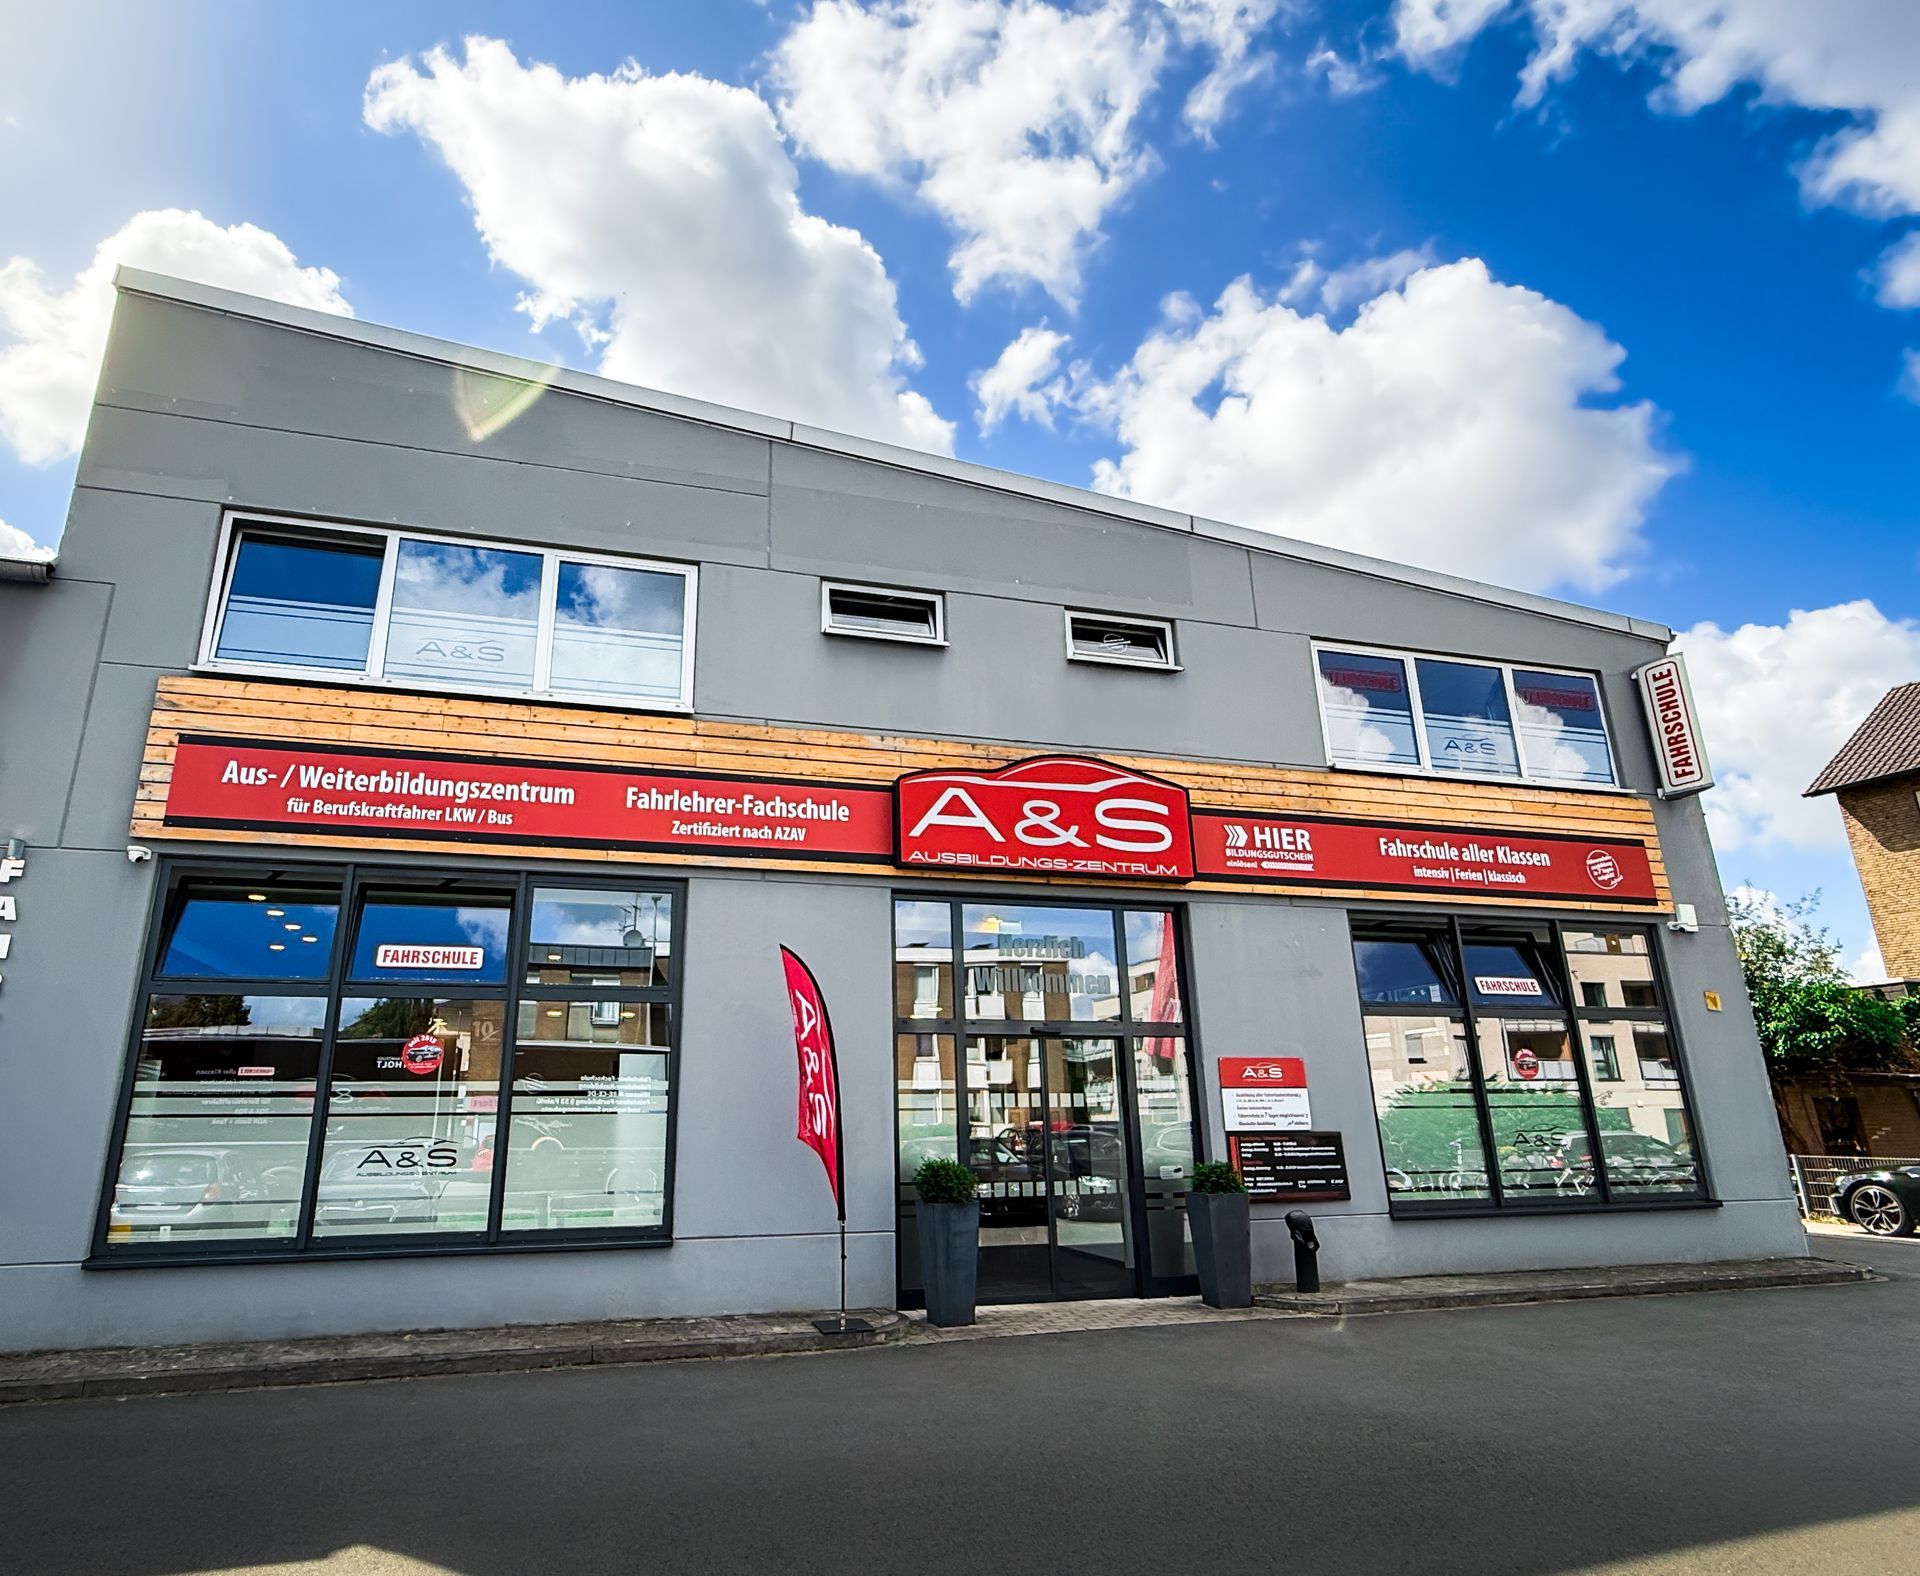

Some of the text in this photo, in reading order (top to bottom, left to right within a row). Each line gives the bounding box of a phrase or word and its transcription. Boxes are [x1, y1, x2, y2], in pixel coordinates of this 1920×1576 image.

[416, 641, 505, 662] A&S
[1652, 668, 1695, 779] FAHRSCHULE
[1443, 739, 1497, 755] A&S
[221, 760, 277, 785] Aus-
[299, 765, 575, 805] Weiterbildungszentrum
[287, 797, 310, 813] für
[313, 799, 443, 821] Berufskraftfahrer
[444, 807, 476, 823] LKW
[487, 809, 513, 825] Bus
[626, 786, 850, 822] Fahrlehrer-Fachschule
[672, 820, 807, 841] Zertifiziert nach AZAV
[908, 787, 1173, 853] A&S
[1253, 826, 1313, 851] HIER
[908, 850, 1178, 875] AUSBILDUNGS-ZENTRUM
[1225, 848, 1314, 861] BILDUNGSGUTSCHEIN
[1378, 837, 1551, 867] Fahrschule aller Klassen
[382, 949, 479, 965] FAHRSCHULE
[997, 933, 1086, 959] Herzlich
[974, 966, 1111, 995] Willkommen
[1479, 980, 1539, 993] FAHRSCHULE
[795, 989, 827, 1140] A&S
[1242, 1067, 1283, 1079] A&S
[1513, 1132, 1568, 1147] A&S
[357, 1148, 457, 1169] A&S
